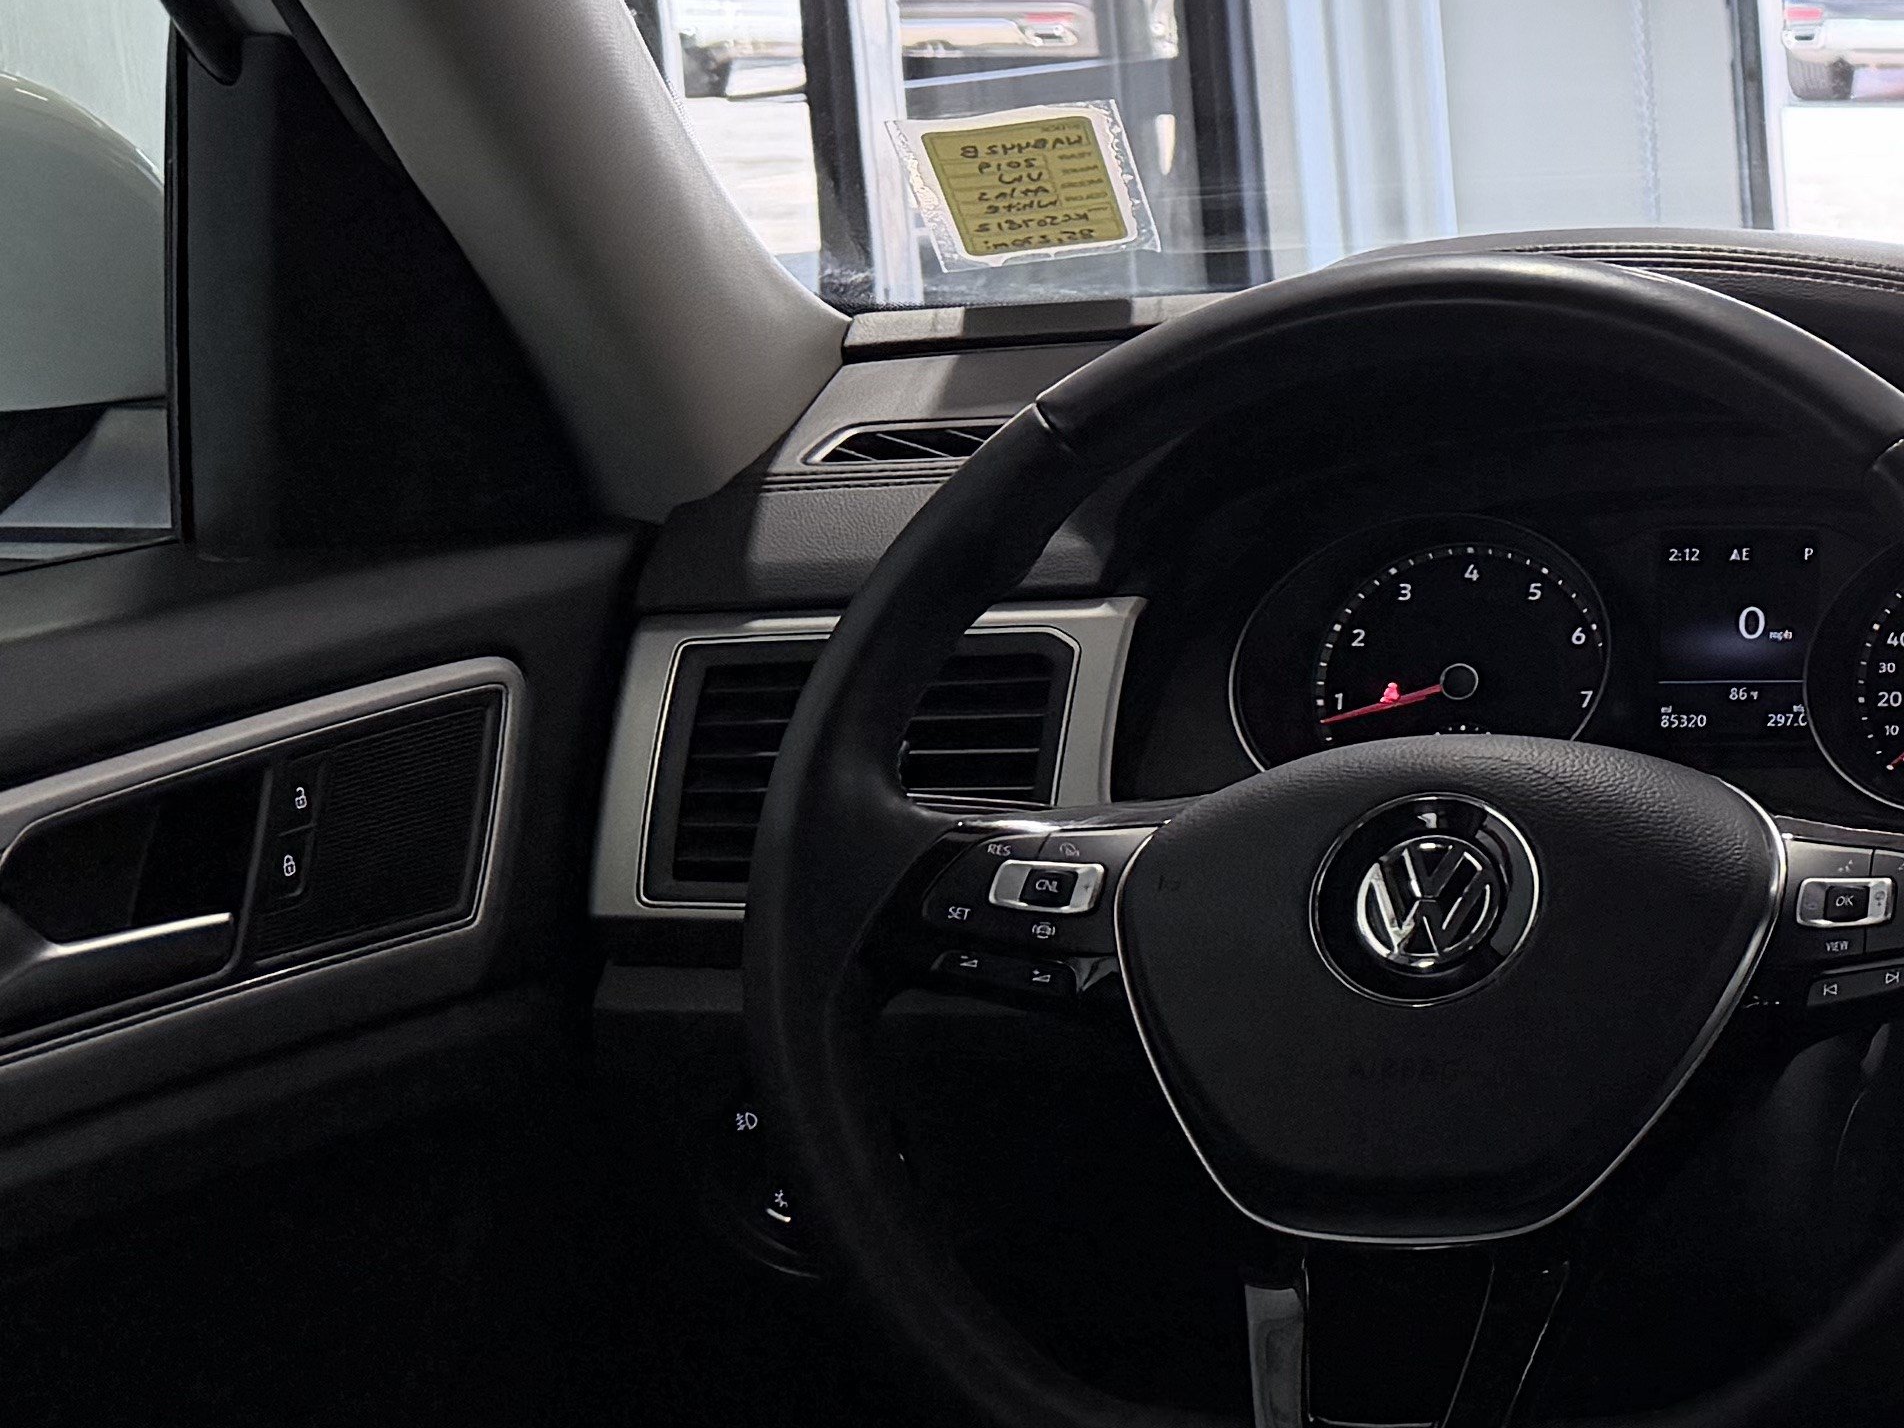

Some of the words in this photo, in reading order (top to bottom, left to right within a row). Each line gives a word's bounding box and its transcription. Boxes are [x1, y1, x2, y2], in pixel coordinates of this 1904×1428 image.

[1668, 548, 1700, 561] 2:12
[1804, 547, 1814, 561] P
[1464, 564, 1480, 581] 4
[1397, 583, 1412, 601] 3
[1528, 583, 1542, 601] 5
[1738, 606, 1766, 640] 0
[1351, 629, 1365, 647] 2
[1571, 627, 1586, 645] 6
[1878, 662, 1896, 673] 30
[1335, 693, 1343, 710] 1
[1580, 690, 1593, 708] 7
[1729, 687, 1748, 701] 86
[1877, 691, 1902, 707] 20
[1660, 714, 1707, 728] 85320
[1884, 725, 1899, 736] 10
[987, 843, 1011, 857] RES
[1835, 894, 1854, 908] OK
[947, 905, 972, 921] SET
[1825, 940, 1850, 952] VIEW
